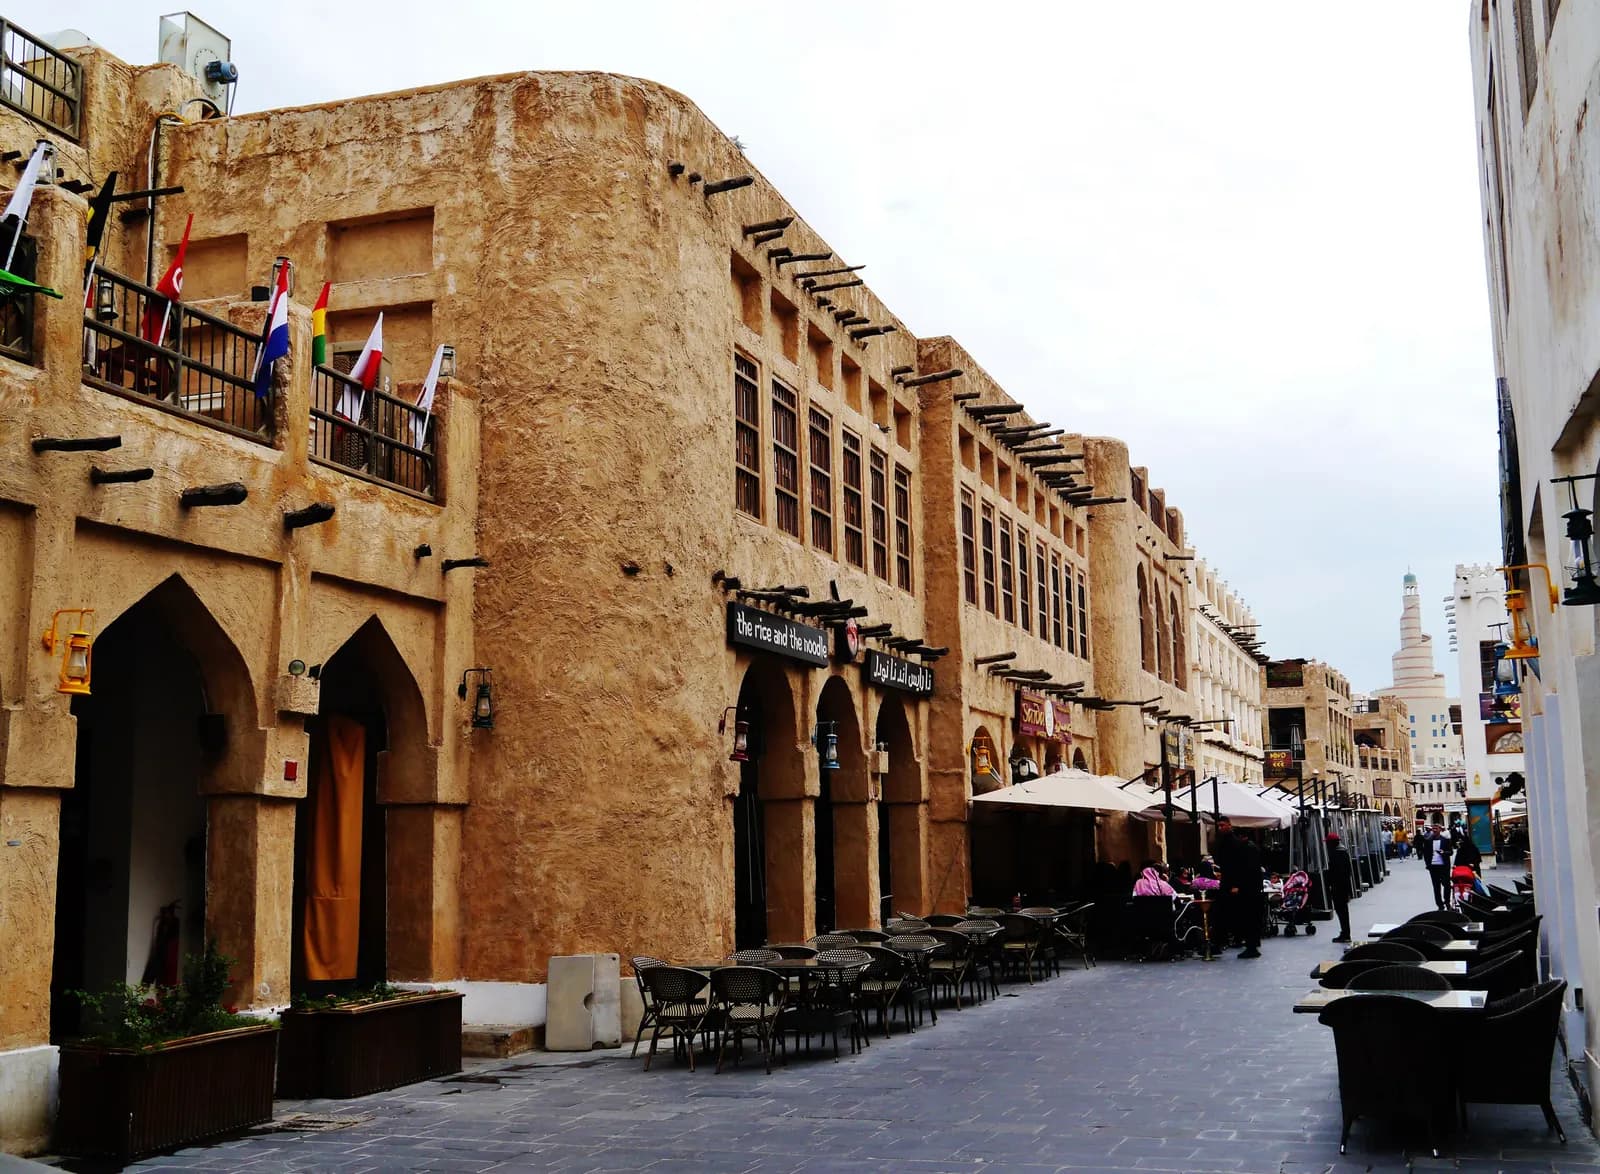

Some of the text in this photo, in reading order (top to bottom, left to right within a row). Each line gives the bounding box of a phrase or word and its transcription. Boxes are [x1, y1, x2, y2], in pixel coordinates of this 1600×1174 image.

[736, 610, 828, 661] the rice and the noodle
